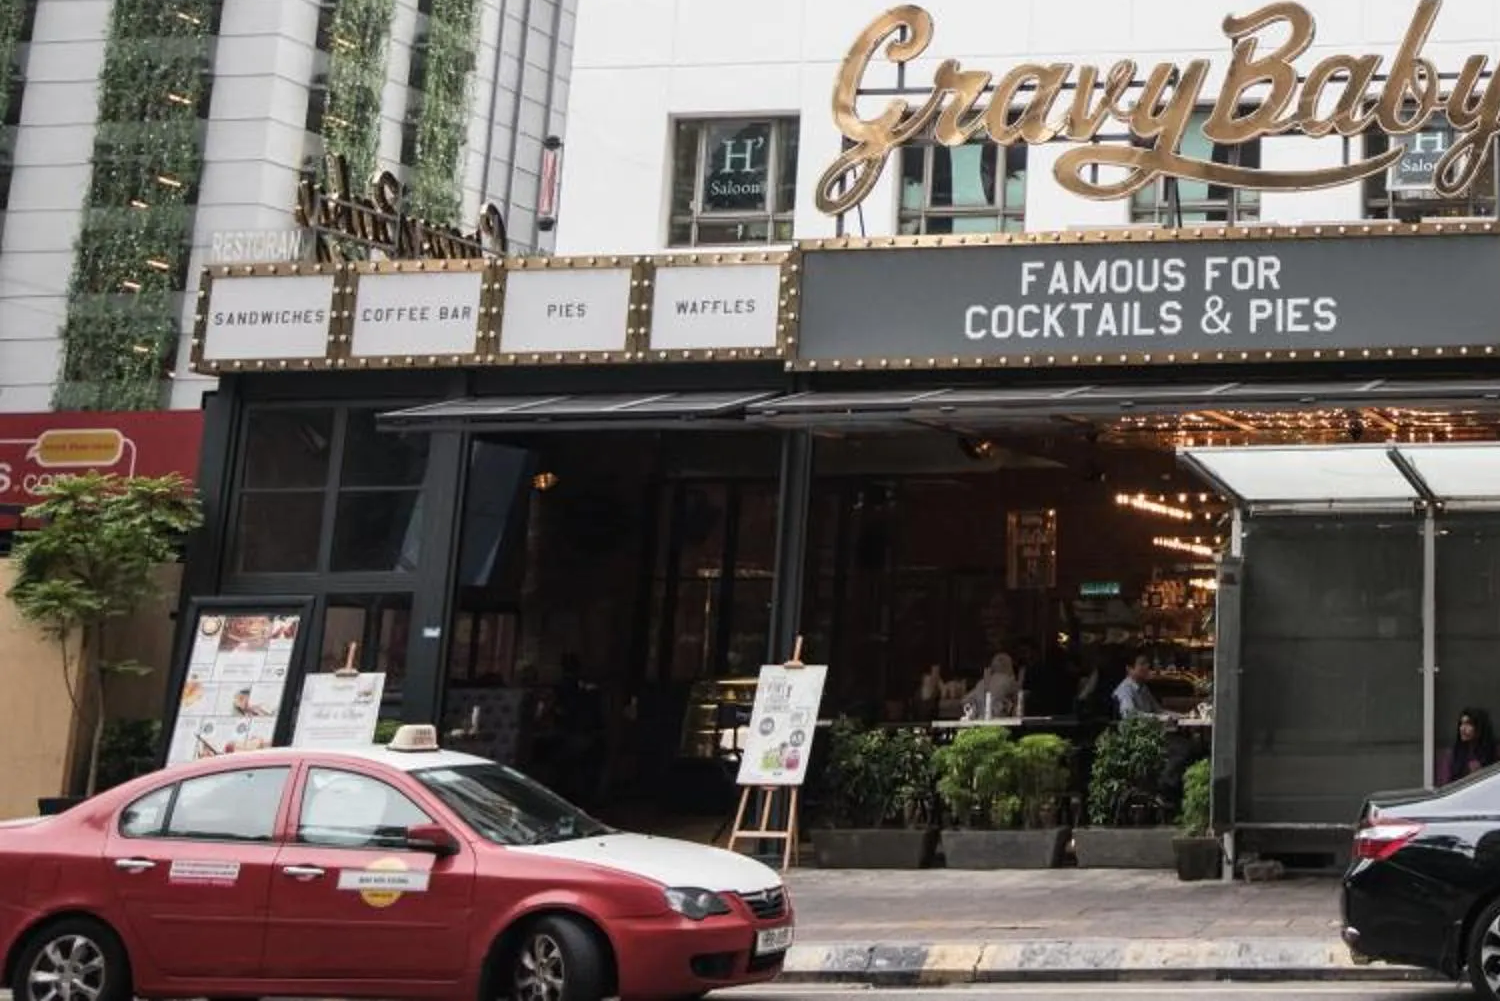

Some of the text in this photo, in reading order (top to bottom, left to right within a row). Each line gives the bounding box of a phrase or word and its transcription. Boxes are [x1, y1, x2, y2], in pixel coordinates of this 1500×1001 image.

[1401, 158, 1434, 173] Salo
[710, 179, 762, 196] Saloon
[1020, 255, 1282, 297] FAMOUS FOR
[361, 305, 473, 323] COFFEE BAR
[546, 302, 587, 318] PIES
[675, 299, 756, 315] WAFFLES
[214, 309, 326, 327] SANDWICHES
[964, 295, 1338, 340] COCKTAILS & PIES
